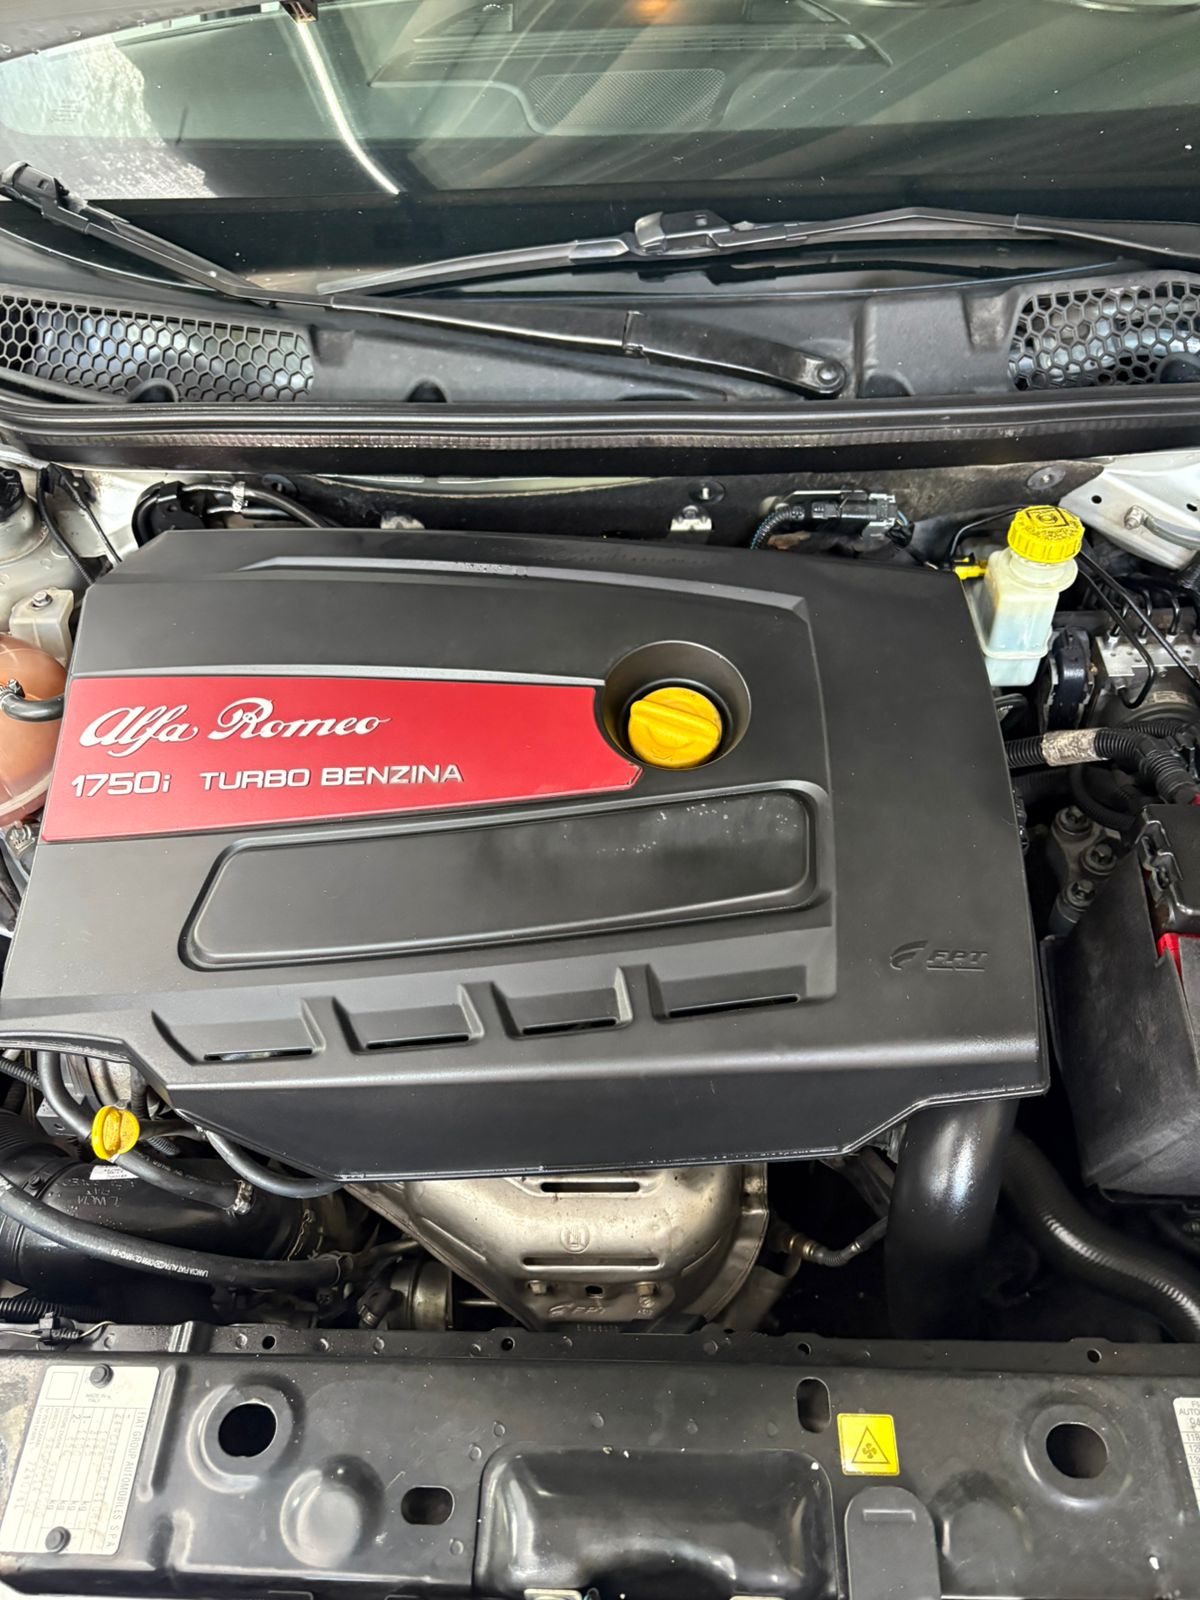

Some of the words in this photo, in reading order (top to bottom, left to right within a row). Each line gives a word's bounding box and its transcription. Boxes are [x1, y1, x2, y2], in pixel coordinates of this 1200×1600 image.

[79, 704, 199, 758] Alfa
[206, 696, 391, 742] Romeo
[71, 768, 171, 798] 1750i
[200, 768, 311, 792] TURBO
[320, 763, 465, 788] BENZINA
[135, 1411, 146, 1427] FIAT
[128, 1431, 141, 1458] GROUP
[112, 1461, 134, 1519] AUTOMOBILES
